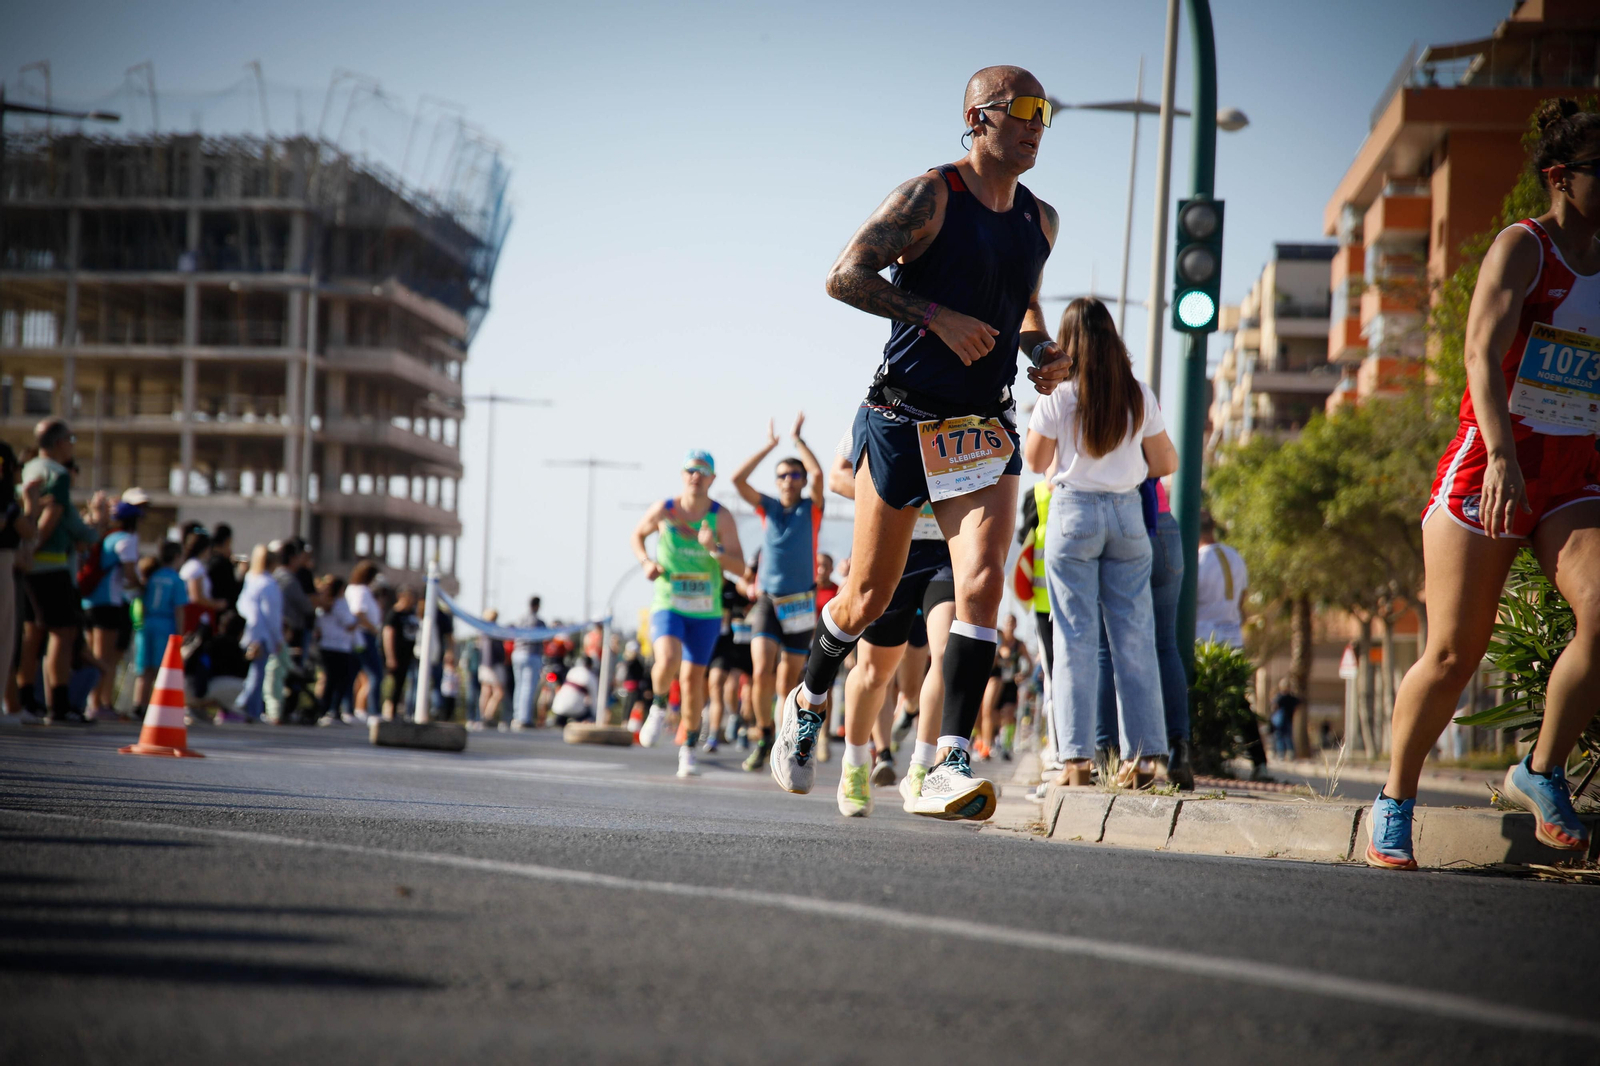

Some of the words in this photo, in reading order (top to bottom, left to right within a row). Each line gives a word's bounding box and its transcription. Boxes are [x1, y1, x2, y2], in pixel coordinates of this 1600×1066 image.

[1539, 343, 1600, 381] 1073
[1537, 370, 1563, 382] NOEMI
[1563, 376, 1593, 388] CABEZAS
[900, 402, 938, 418] performance
[931, 427, 1003, 458] 1776
[949, 449, 993, 464] SLEBIBERJI
